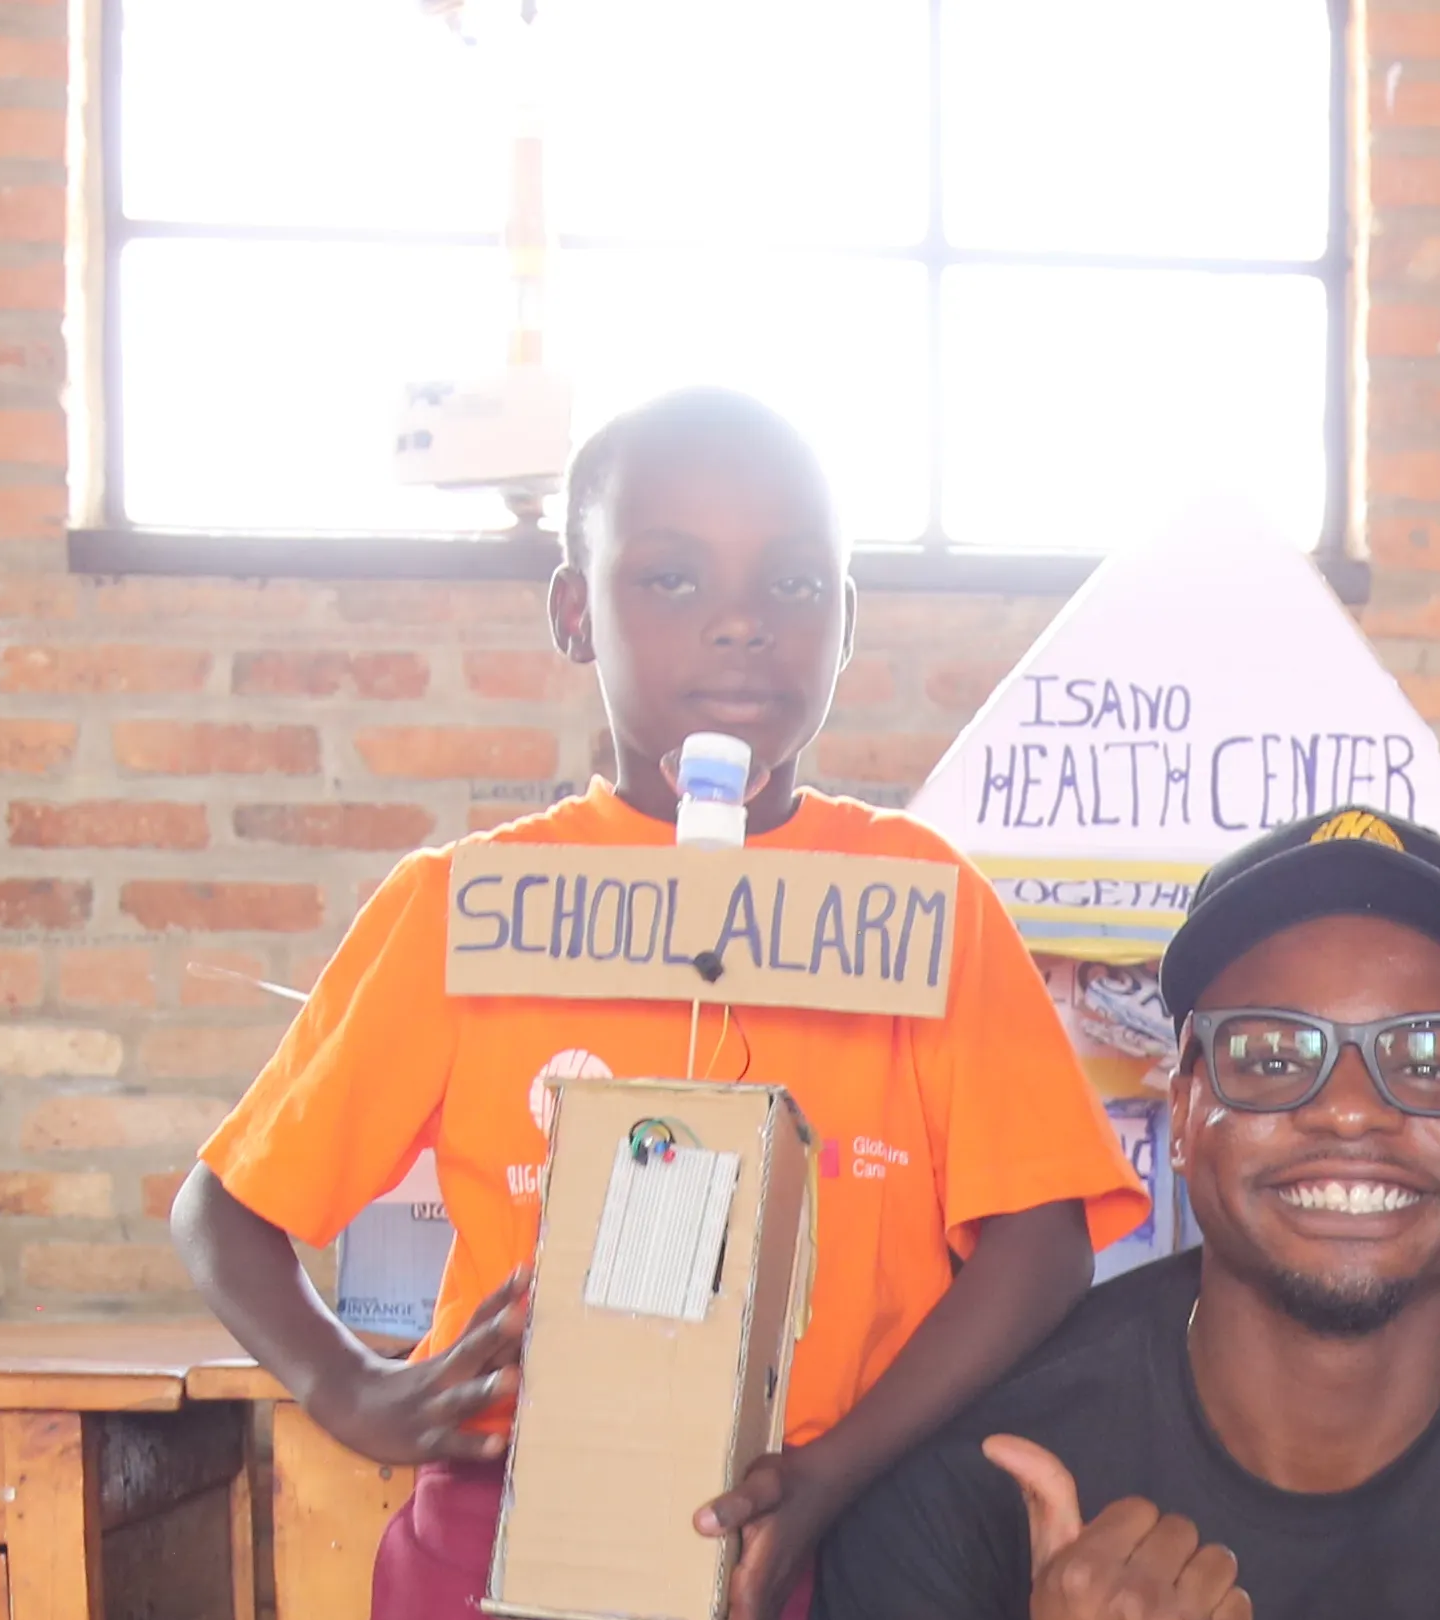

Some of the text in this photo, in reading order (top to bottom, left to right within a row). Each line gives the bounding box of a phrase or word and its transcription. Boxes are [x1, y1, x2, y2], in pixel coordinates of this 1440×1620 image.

[1018, 674, 1192, 733] ISANO
[976, 732, 1417, 831] HEALTH CENTER
[453, 873, 949, 988] SCHOOL ALARM
